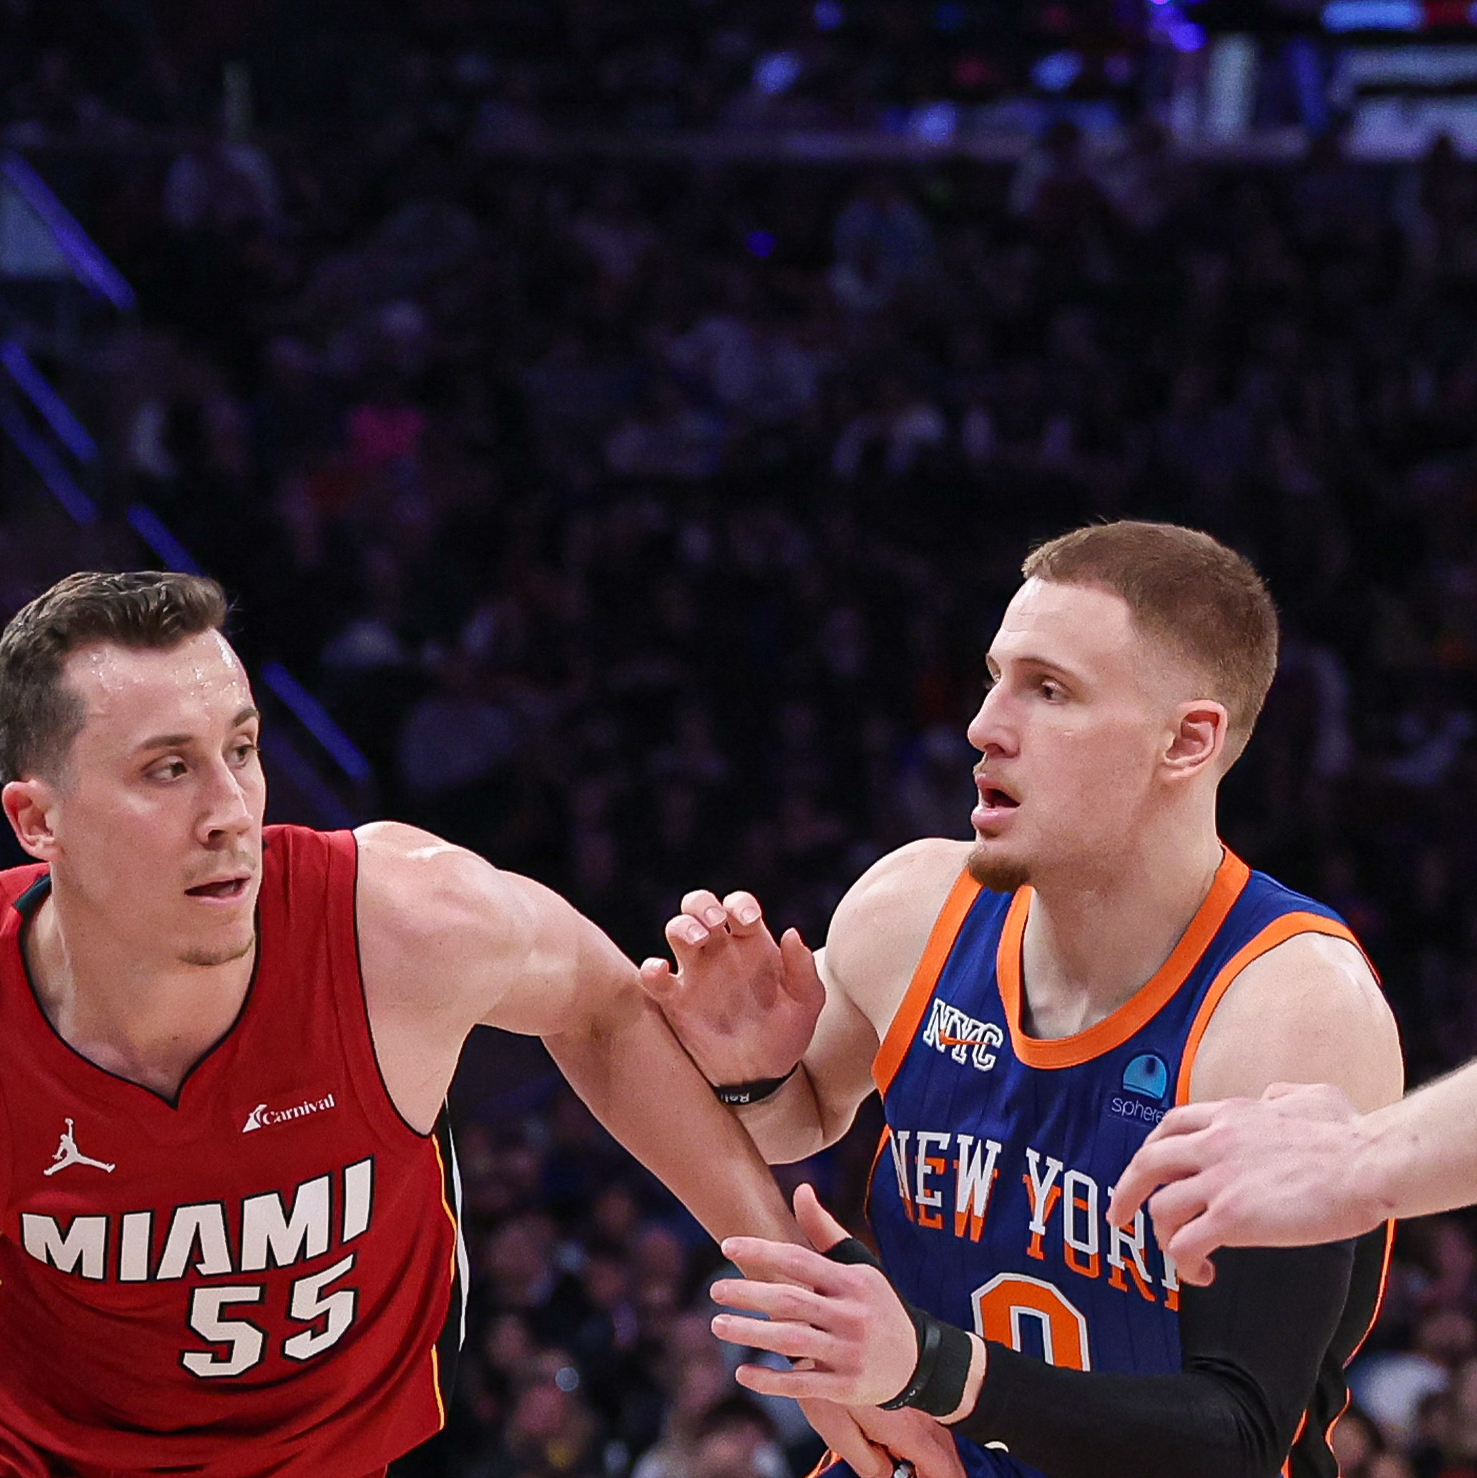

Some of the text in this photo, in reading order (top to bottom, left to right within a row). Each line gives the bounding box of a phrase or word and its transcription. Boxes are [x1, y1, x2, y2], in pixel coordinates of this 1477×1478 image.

[923, 997, 1003, 1072] NYC
[263, 1093, 335, 1127] Carnival
[1111, 1097, 1164, 1124] sphere
[20, 1156, 373, 1282] MIAMI
[888, 1129, 1002, 1242] NEW
[181, 1253, 356, 1378] 55
